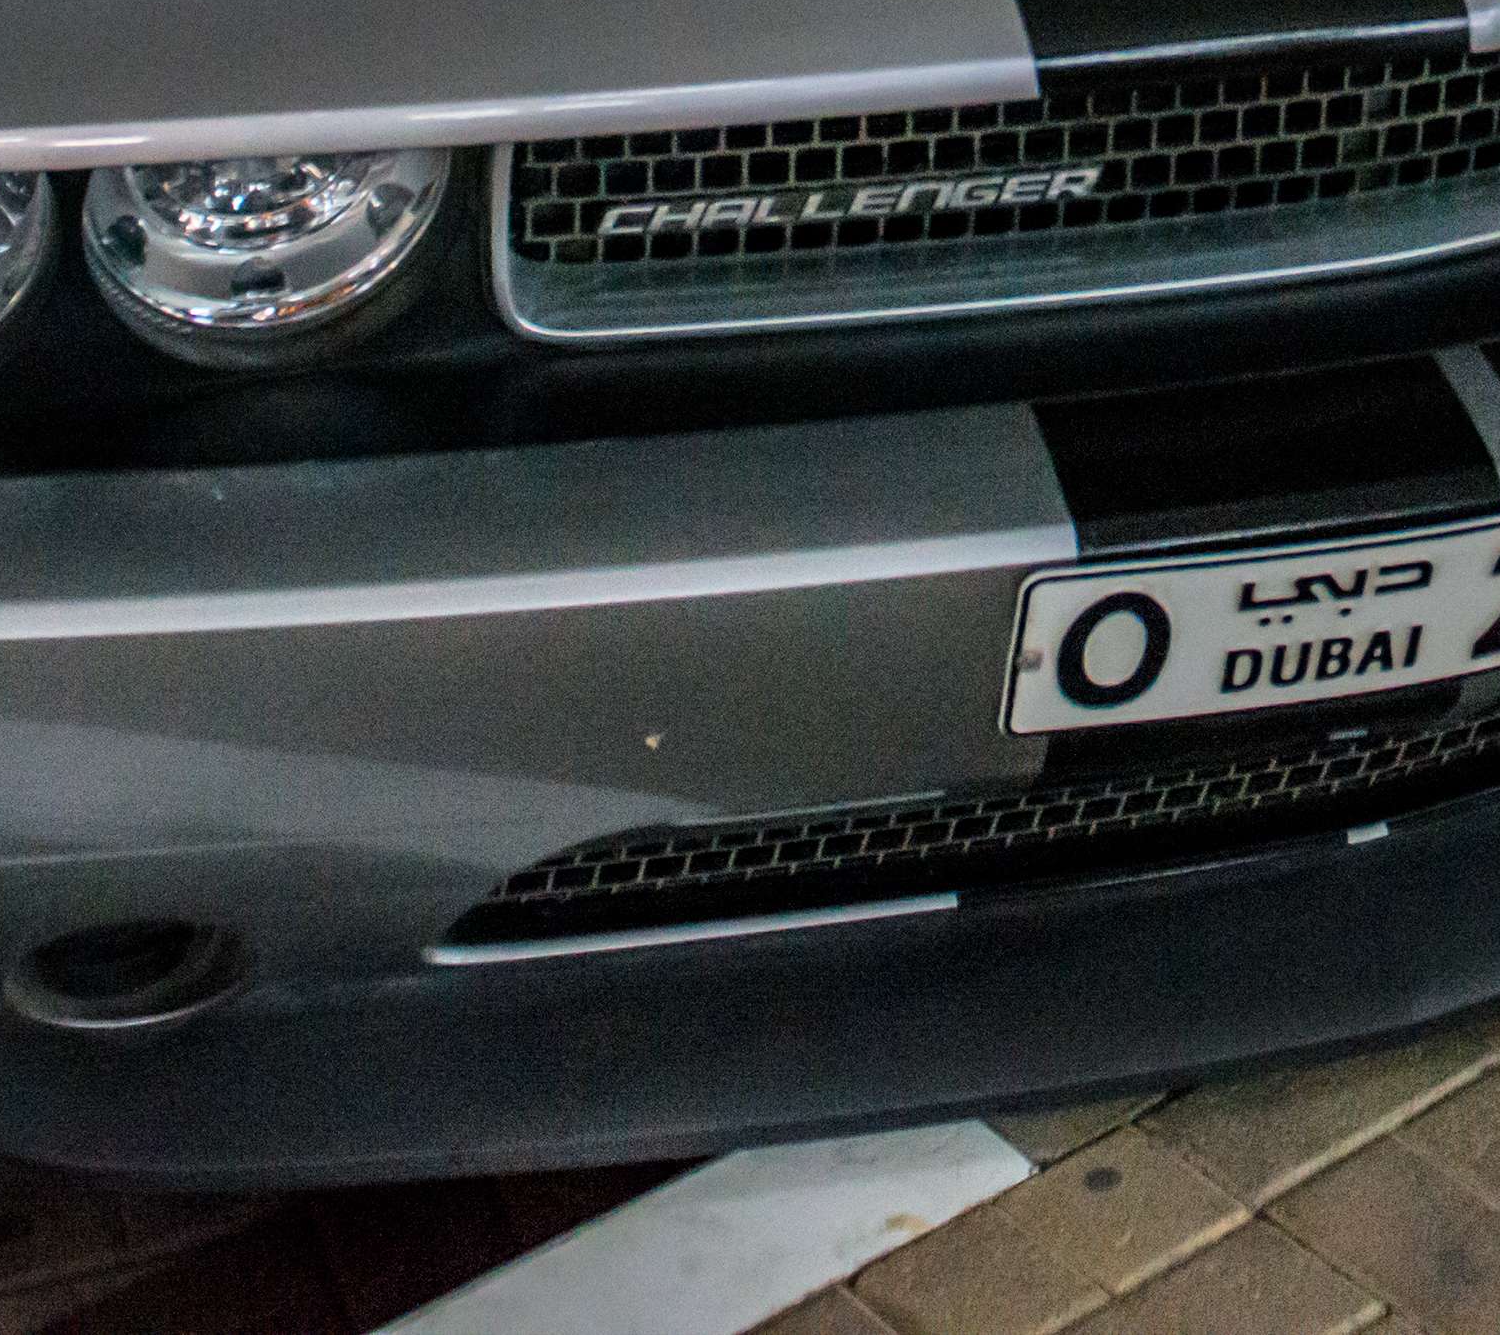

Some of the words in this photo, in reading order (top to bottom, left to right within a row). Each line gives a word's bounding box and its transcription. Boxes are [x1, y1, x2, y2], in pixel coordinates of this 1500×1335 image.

[598, 165, 1105, 236] CHALLENGER
[1238, 558, 1433, 627] دبي
[1057, 591, 1171, 707] O
[1220, 625, 1426, 695] DUBAI
